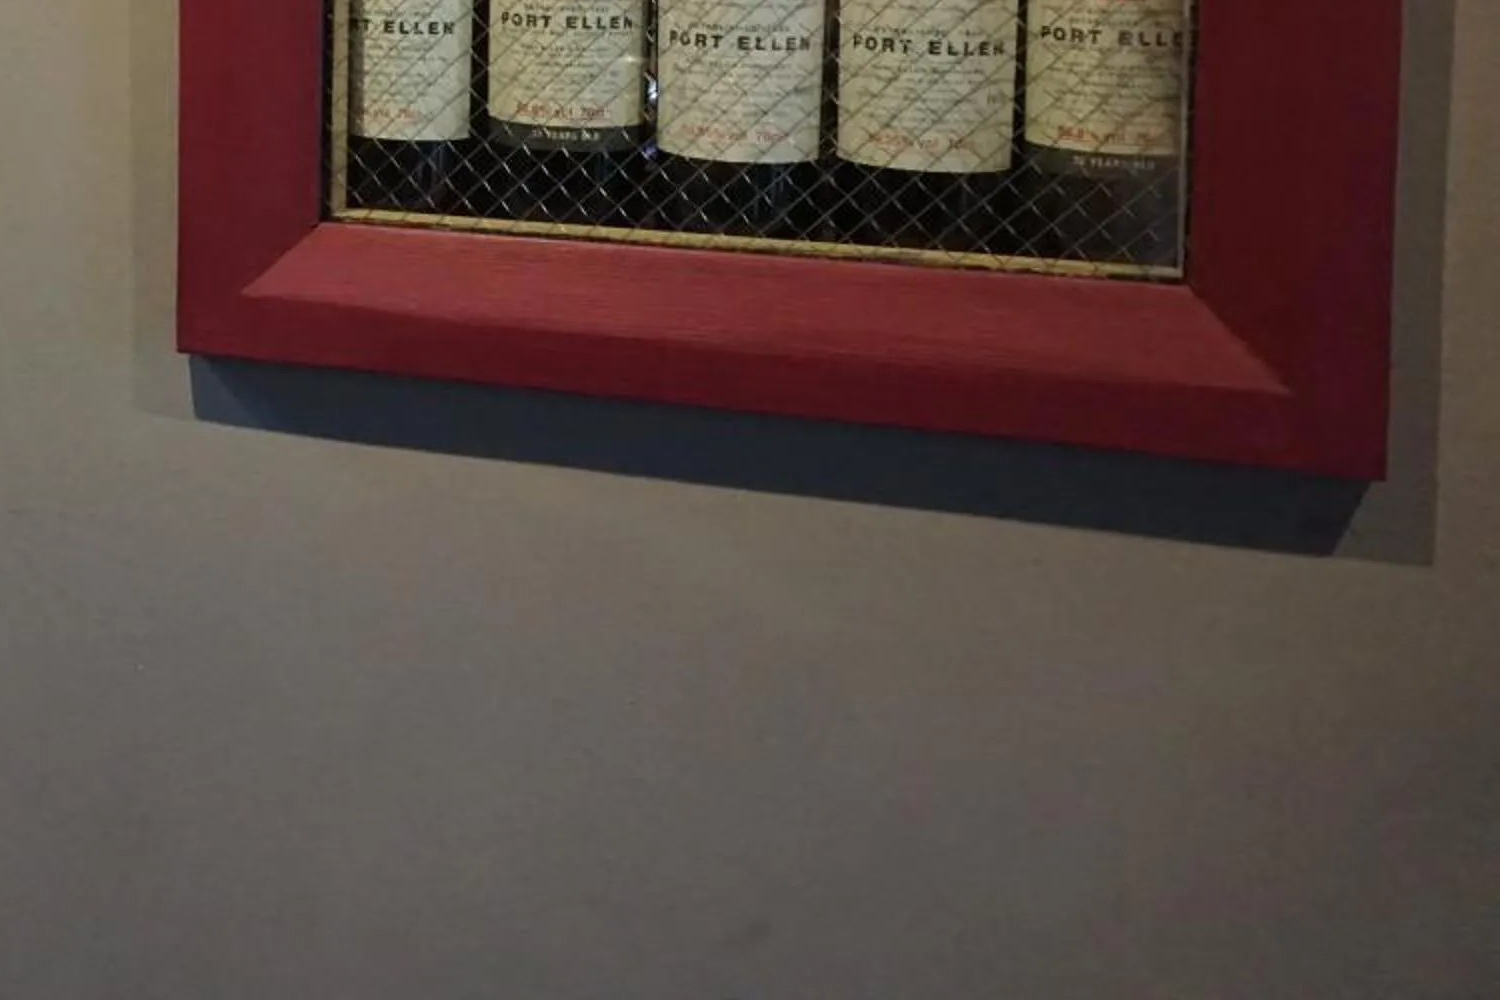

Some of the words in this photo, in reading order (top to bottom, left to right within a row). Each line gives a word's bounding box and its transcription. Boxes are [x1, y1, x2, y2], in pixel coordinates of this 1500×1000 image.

[383, 20, 456, 36] ELLEN
[501, 11, 553, 30] PORT
[566, 14, 634, 31] ELLEN
[668, 28, 724, 51] PORT
[738, 33, 811, 53] ELLEN
[852, 31, 912, 54] PORT
[928, 38, 1005, 58] ELLEN
[1040, 25, 1103, 46] PORT
[1118, 29, 1188, 49] ELLE
